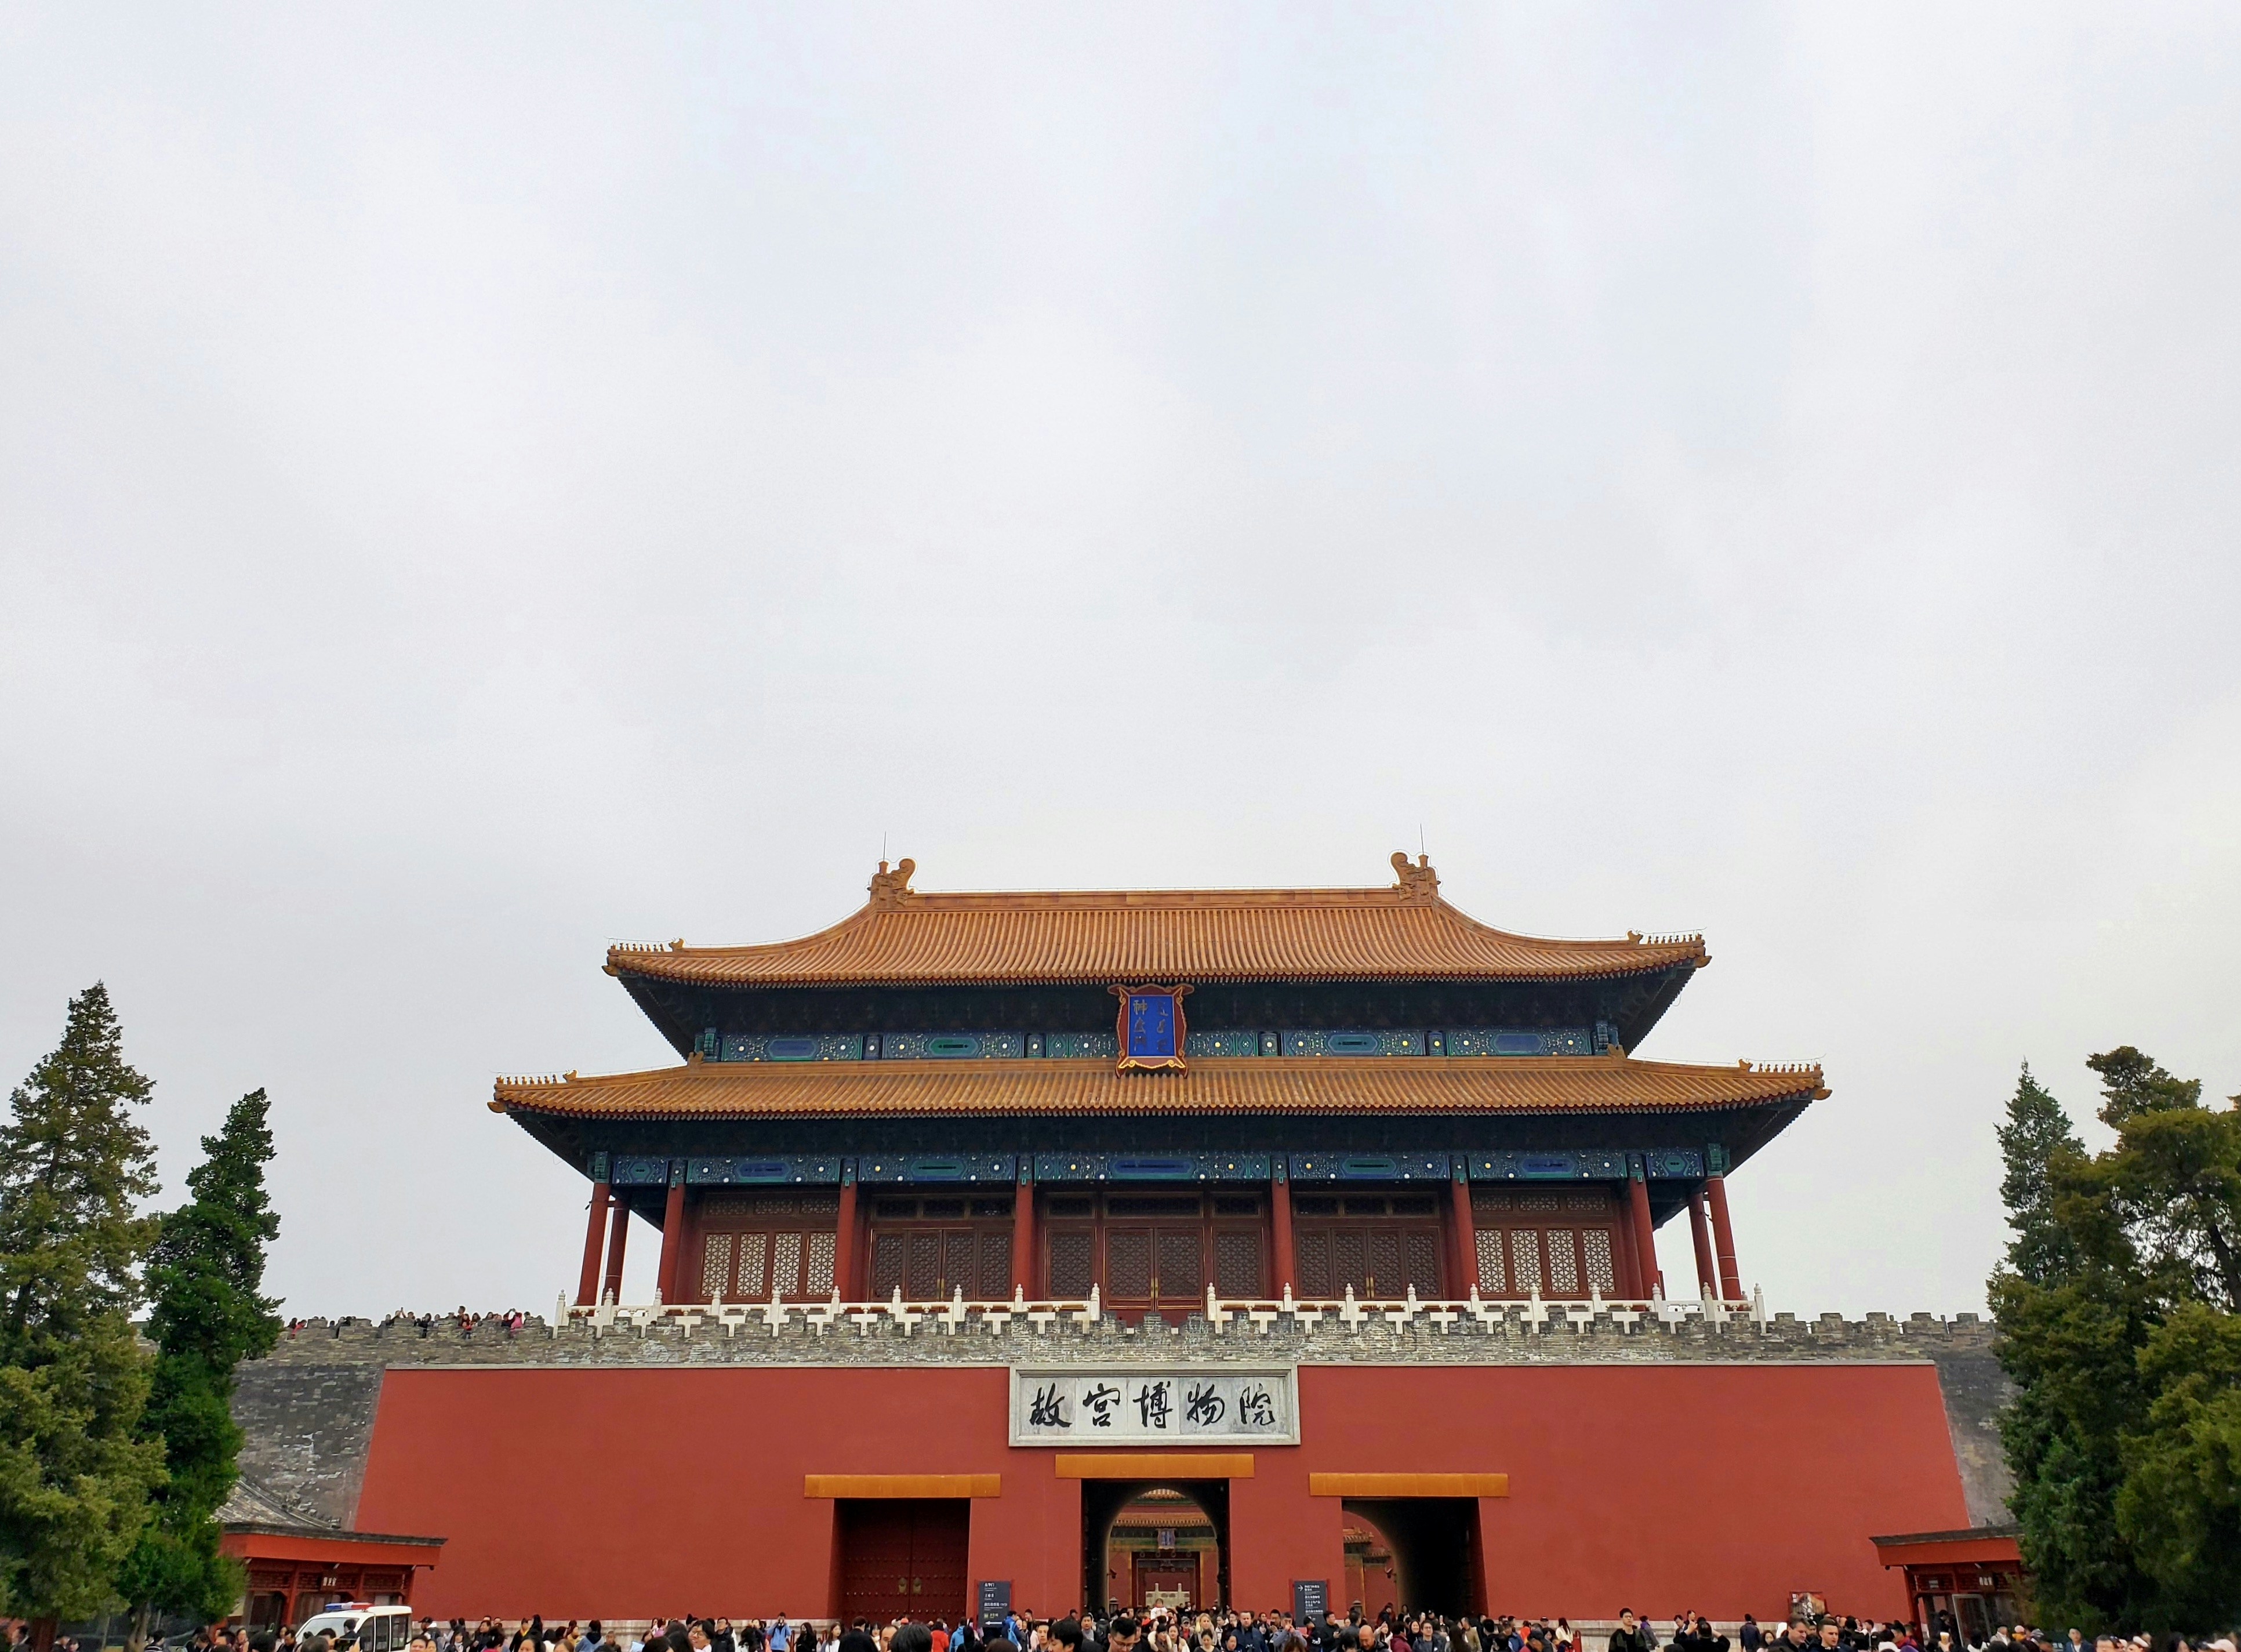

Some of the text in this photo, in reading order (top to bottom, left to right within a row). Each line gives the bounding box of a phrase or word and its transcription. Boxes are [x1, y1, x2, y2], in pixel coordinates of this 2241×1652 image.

[1029, 1380, 1275, 1429] 故宫博物院
